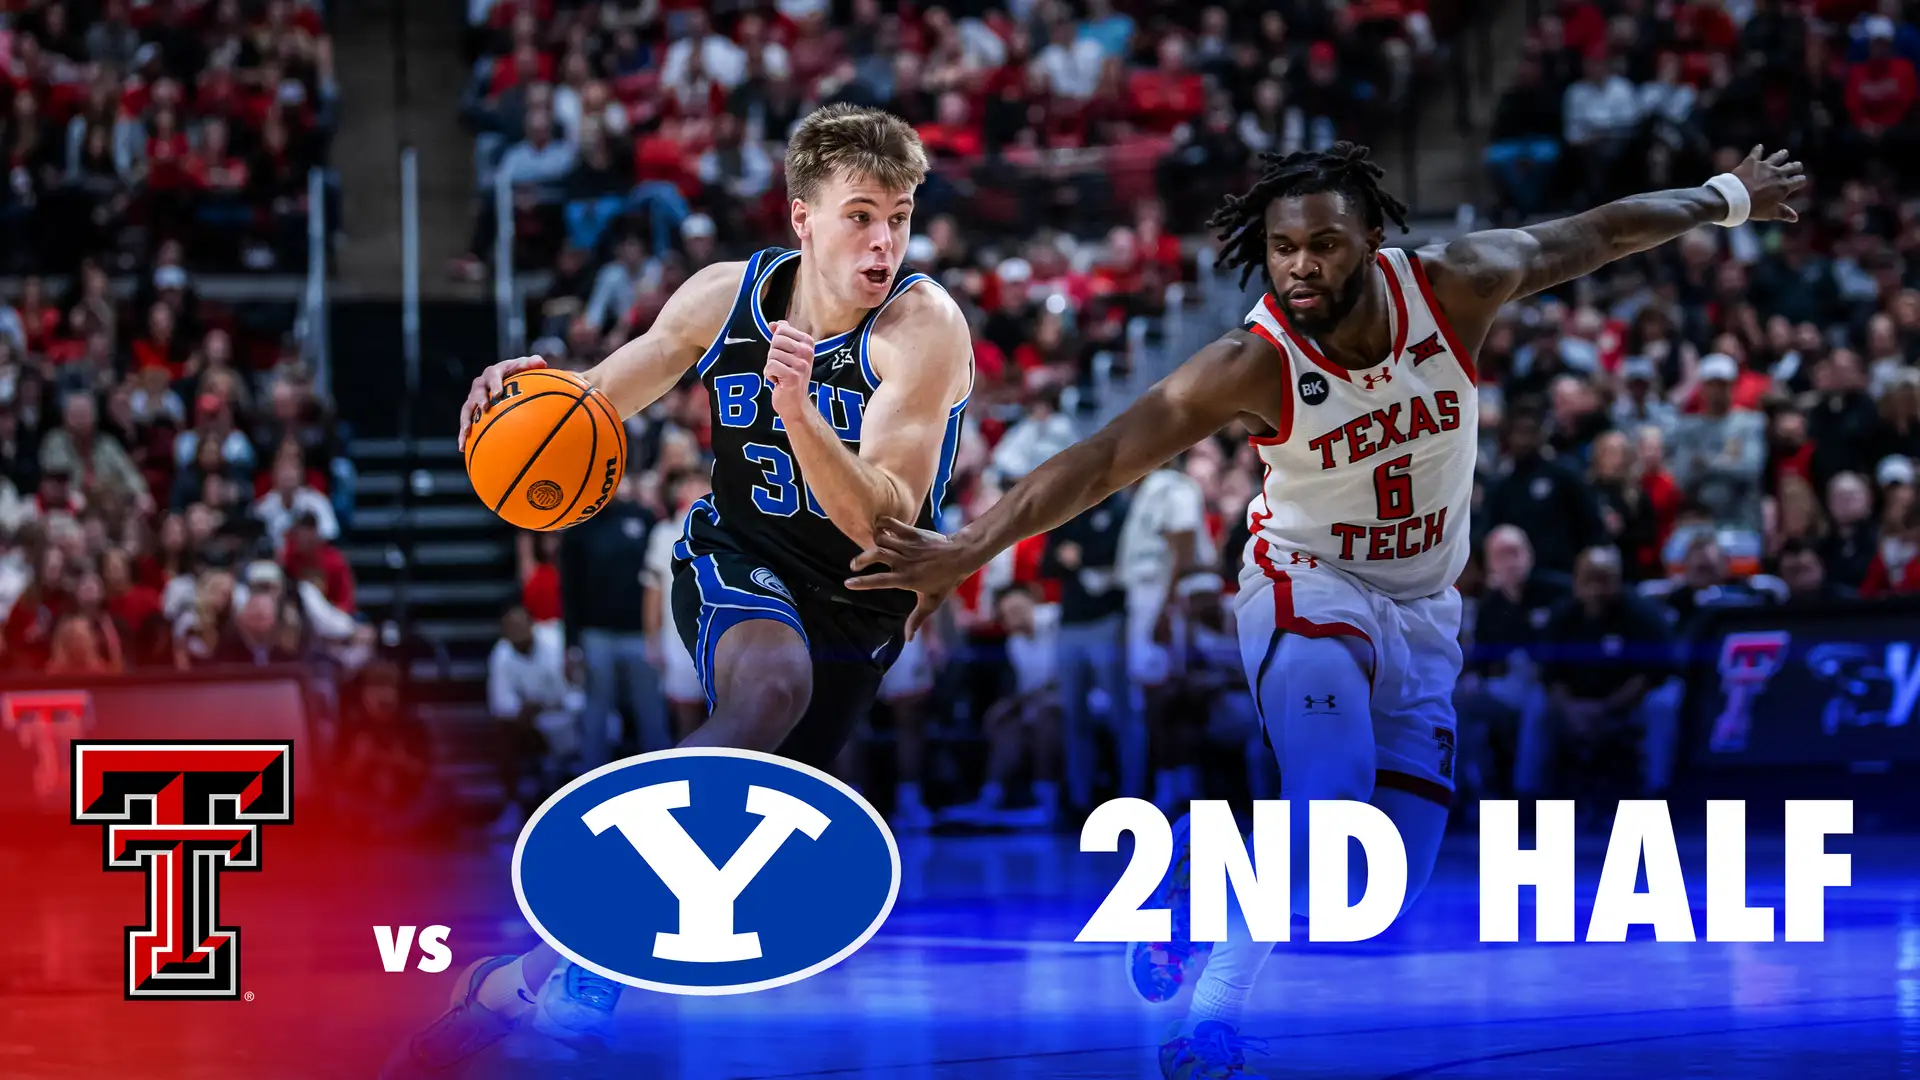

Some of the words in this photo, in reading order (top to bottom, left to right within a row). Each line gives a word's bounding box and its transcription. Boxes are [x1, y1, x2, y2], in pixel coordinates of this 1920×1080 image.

[1301, 380, 1325, 397] BK
[1309, 390, 1460, 470] TEXAS
[1373, 454, 1414, 521] 6
[1331, 506, 1448, 560] TECH
